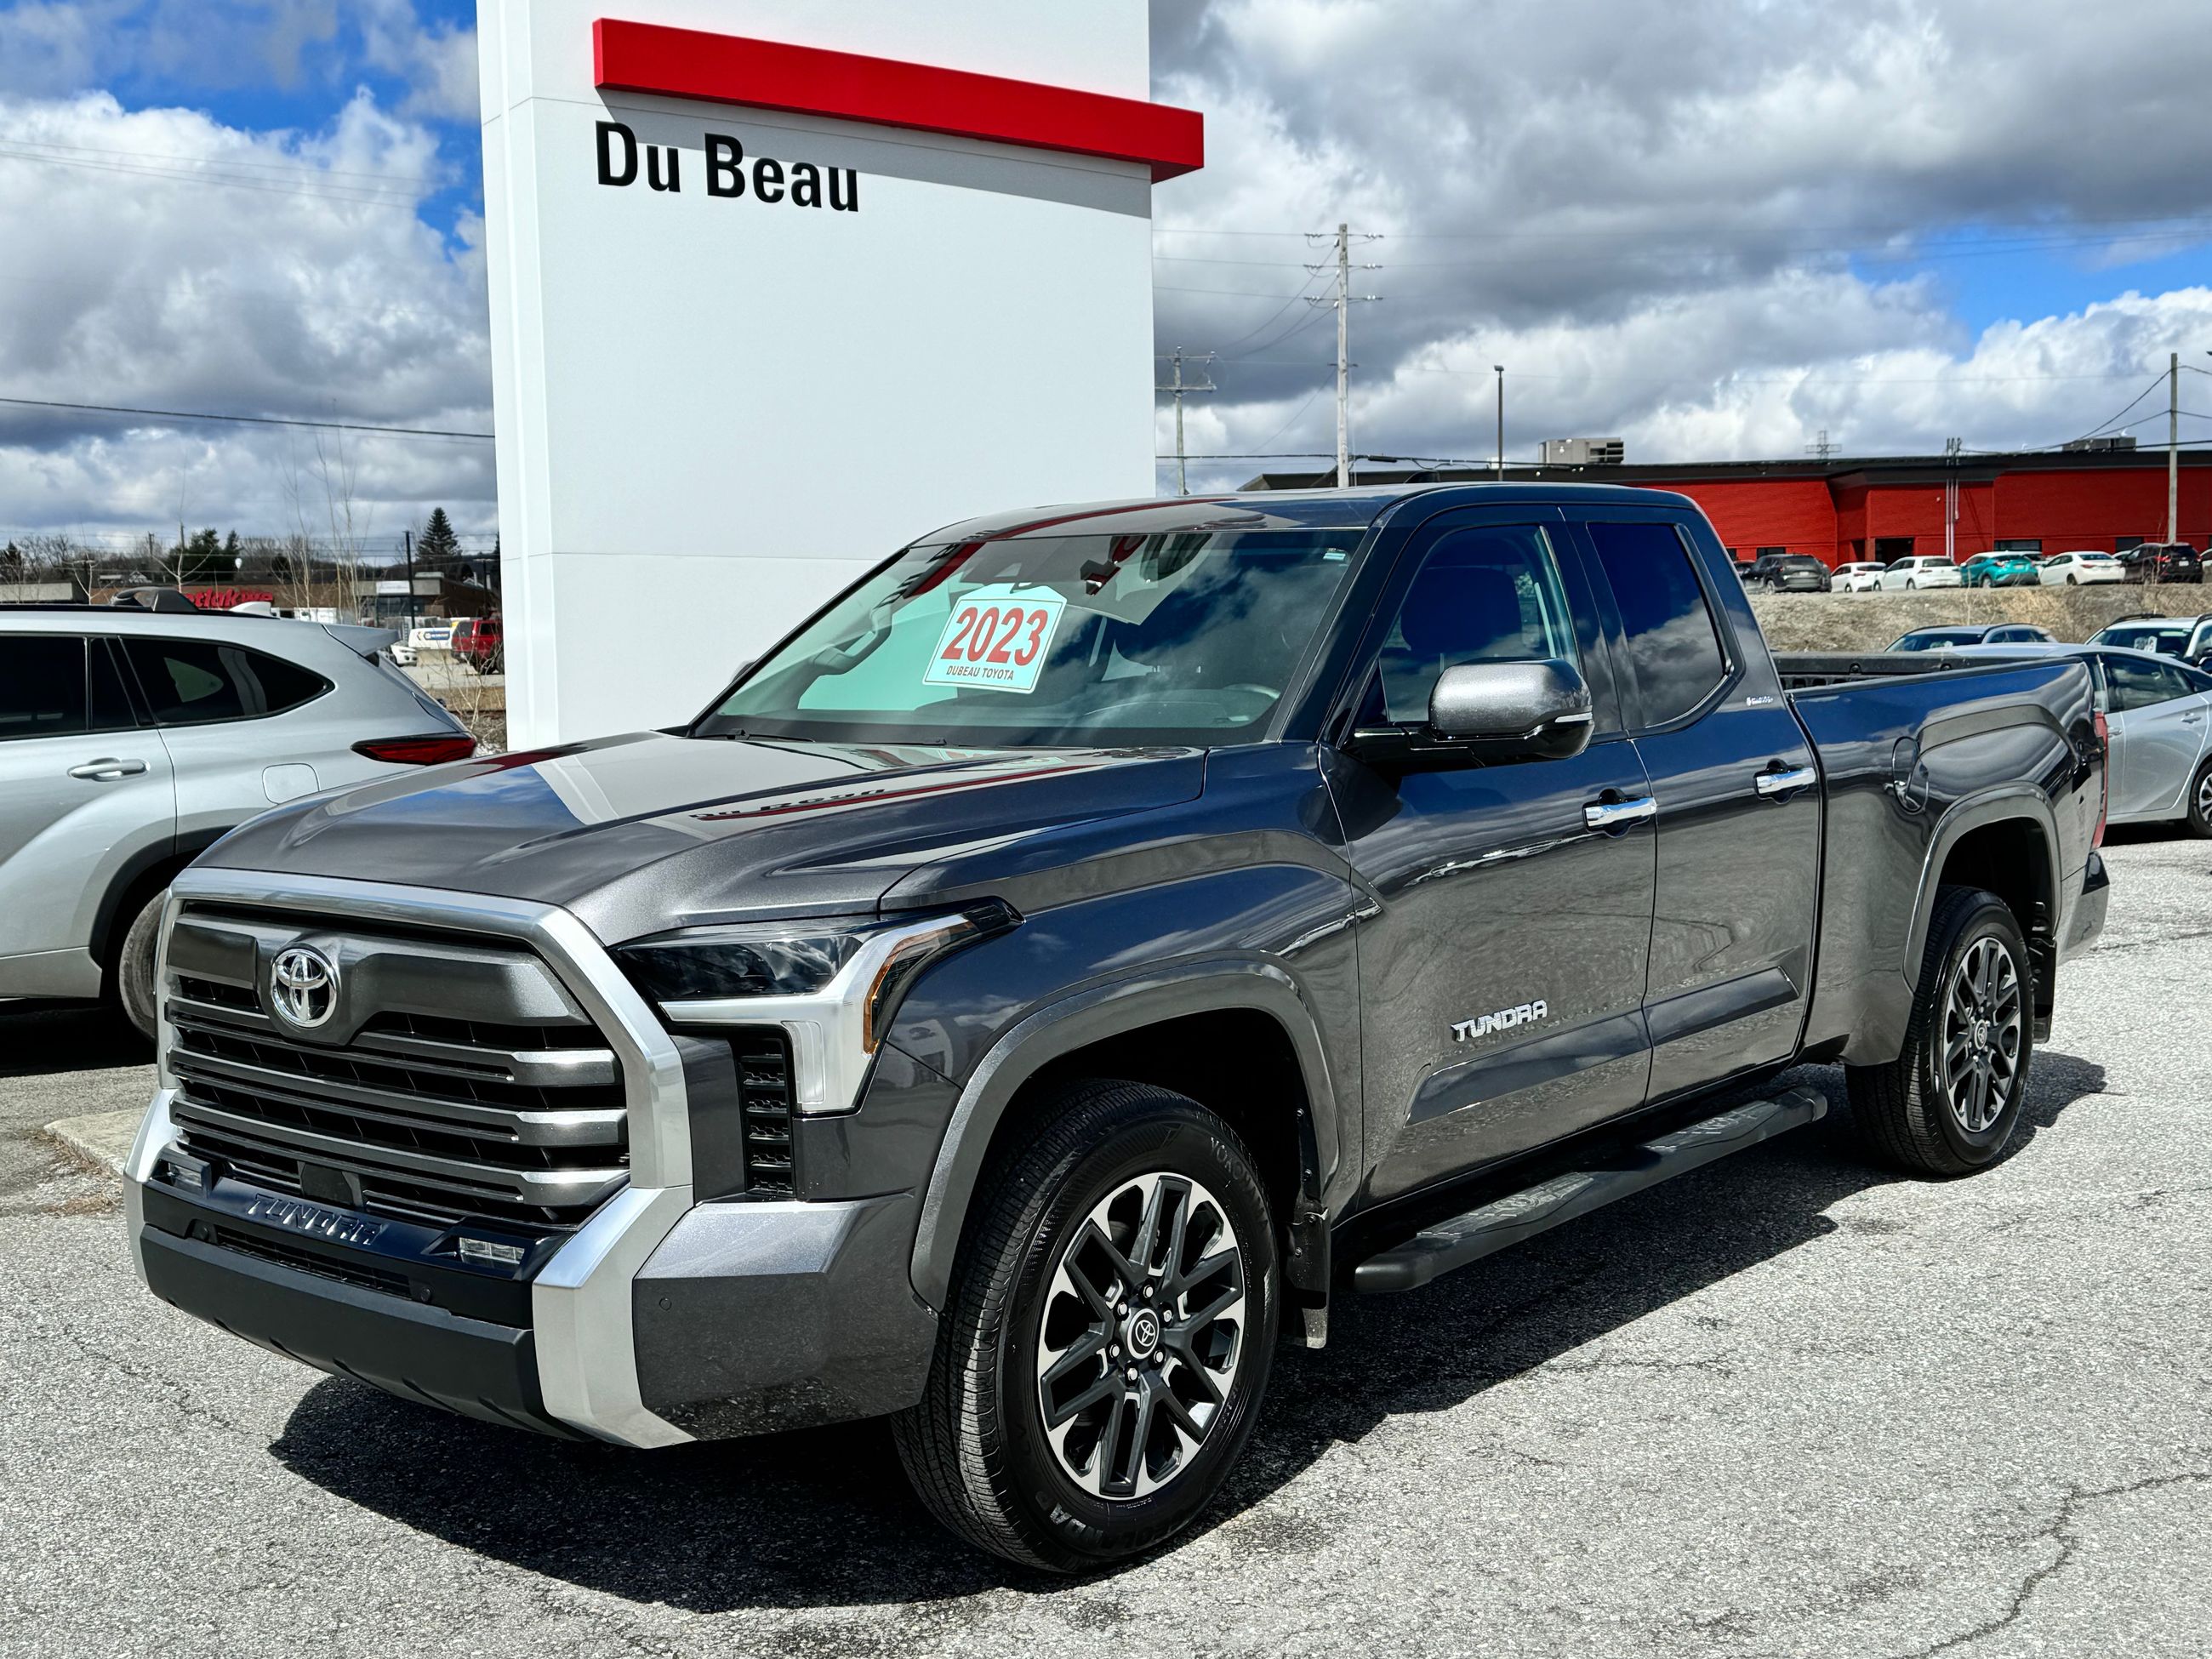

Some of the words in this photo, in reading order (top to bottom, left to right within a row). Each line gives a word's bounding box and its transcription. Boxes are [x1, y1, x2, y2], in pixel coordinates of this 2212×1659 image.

[596, 120, 681, 192] Du
[704, 133, 858, 212] Beau
[941, 607, 1049, 666] 2023
[946, 665, 980, 677] DUBEAU
[982, 667, 1014, 681] TOYOTA
[1451, 1000, 1548, 1042] TUNDRA
[248, 1193, 382, 1246] TUNDRA
